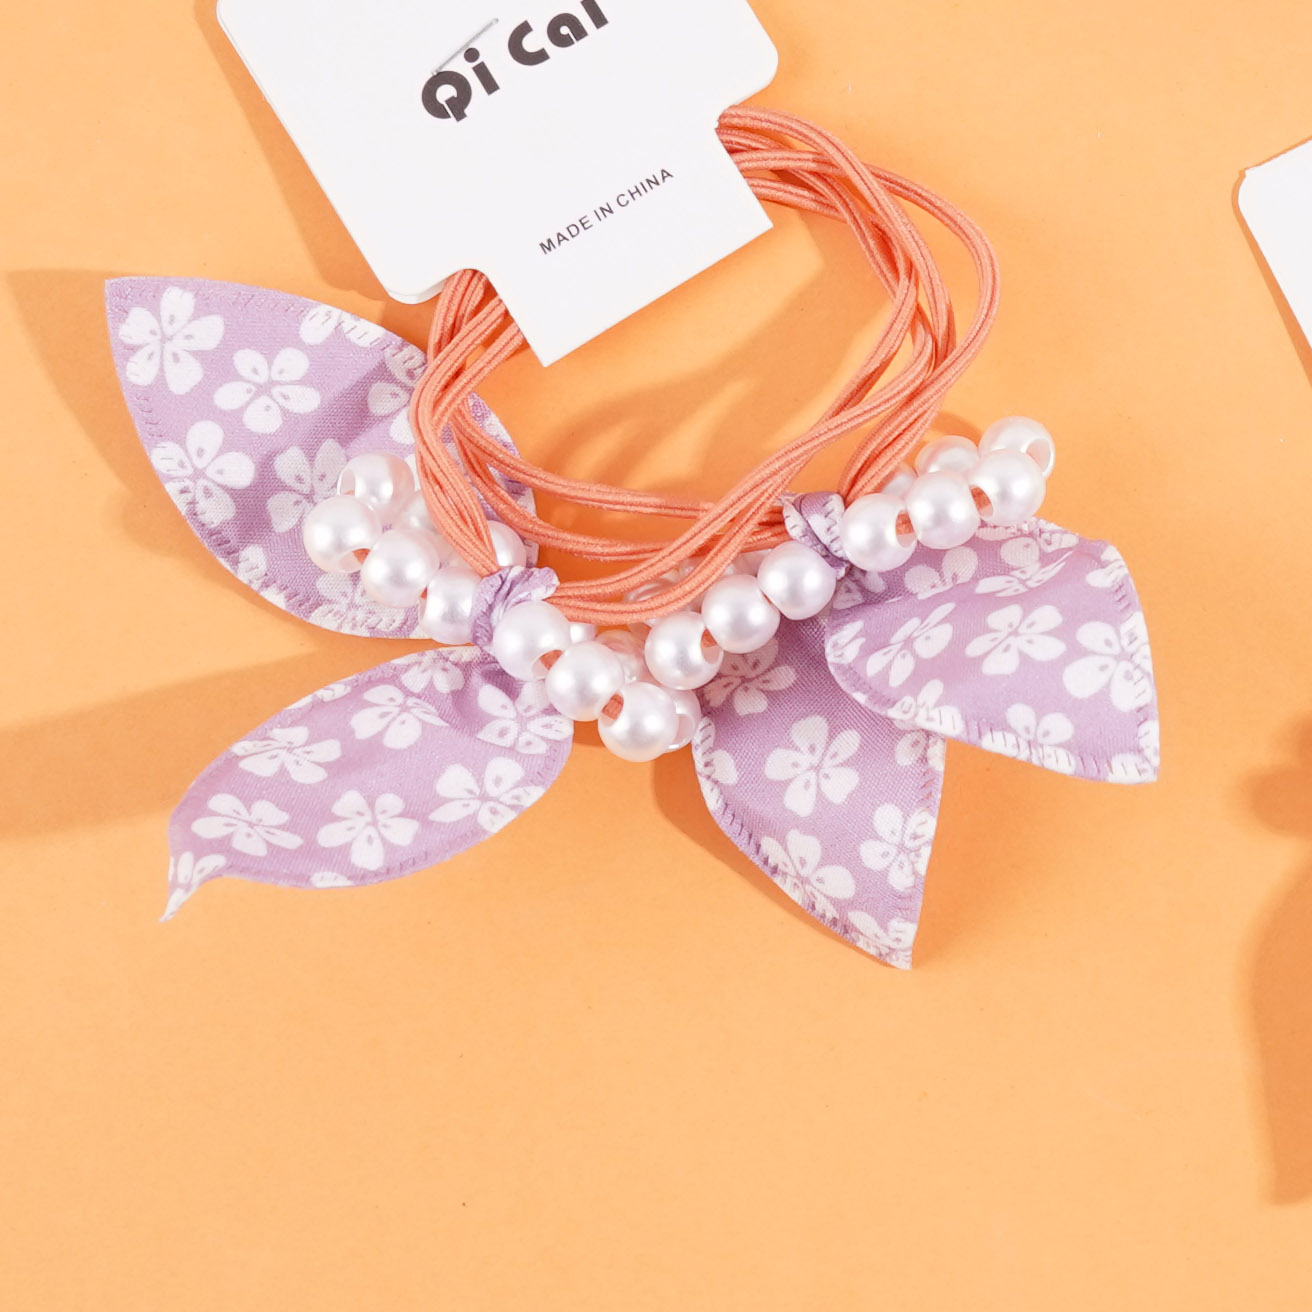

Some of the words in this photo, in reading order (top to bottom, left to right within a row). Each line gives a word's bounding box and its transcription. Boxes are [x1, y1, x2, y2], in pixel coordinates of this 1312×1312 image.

[421, 47, 500, 122] Qi
[539, 215, 593, 255] MADE
[593, 202, 615, 222] IN
[616, 168, 674, 208] CHINA
